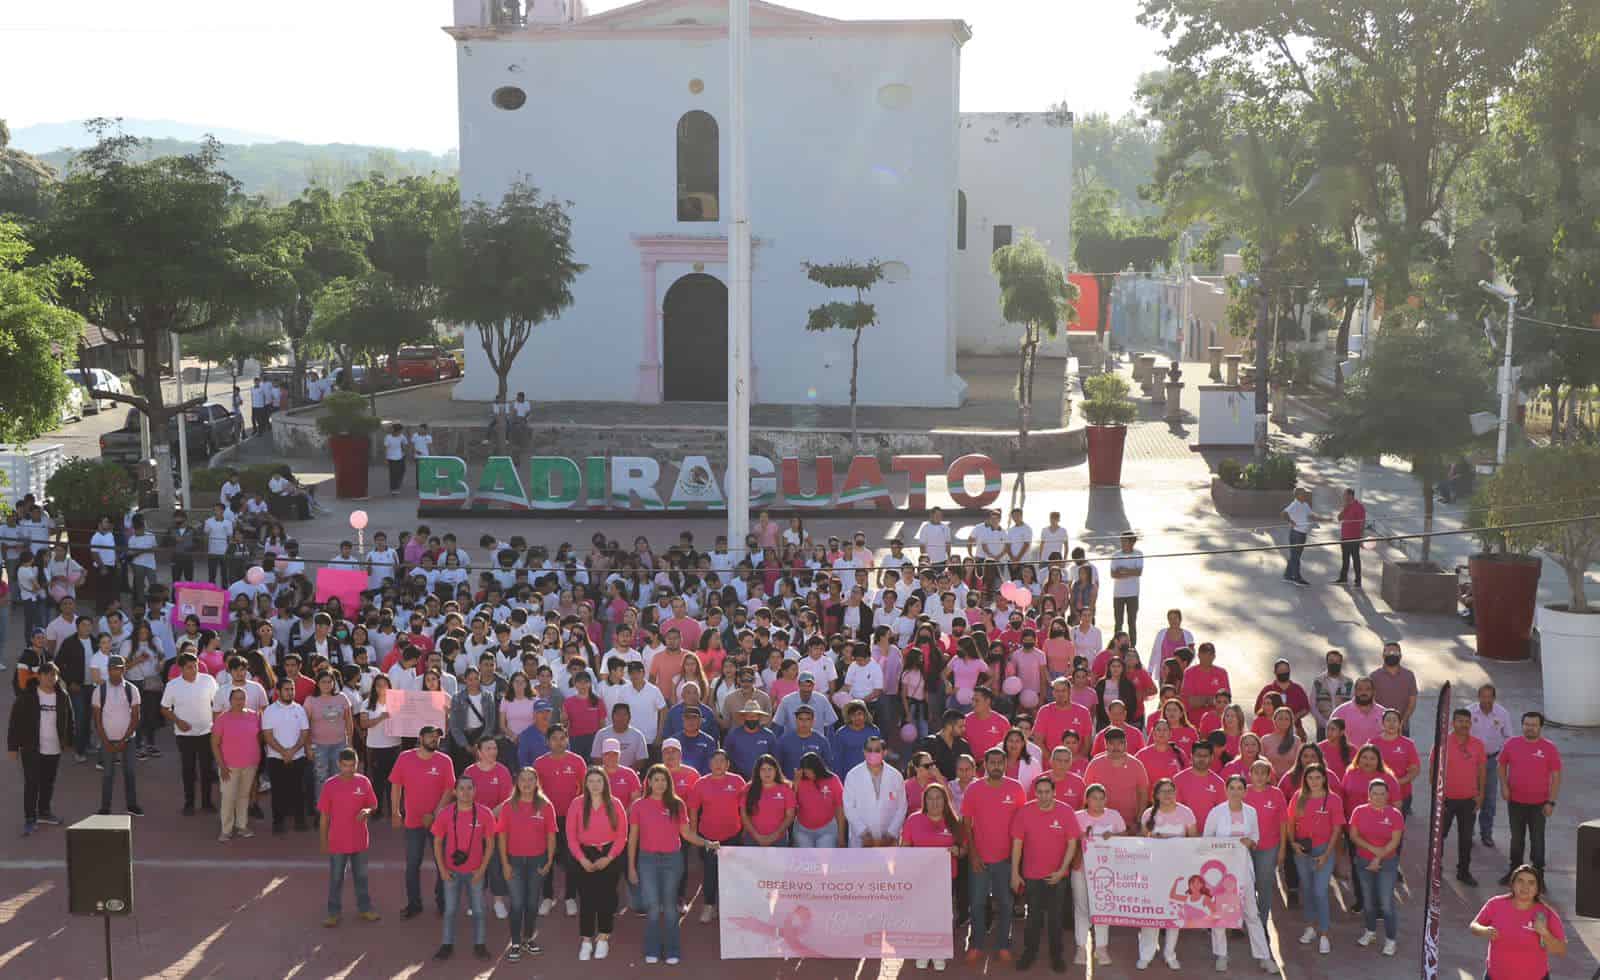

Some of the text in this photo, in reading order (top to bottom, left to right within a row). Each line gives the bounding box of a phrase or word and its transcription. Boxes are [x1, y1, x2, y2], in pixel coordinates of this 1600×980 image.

[417, 453, 1001, 510] BADIRAGUATO
[821, 880, 854, 891] TOCO
[857, 881, 864, 890] Y
[868, 881, 912, 891] SIENTO
[1116, 881, 1149, 889] contra
[1119, 904, 1165, 914] mama
